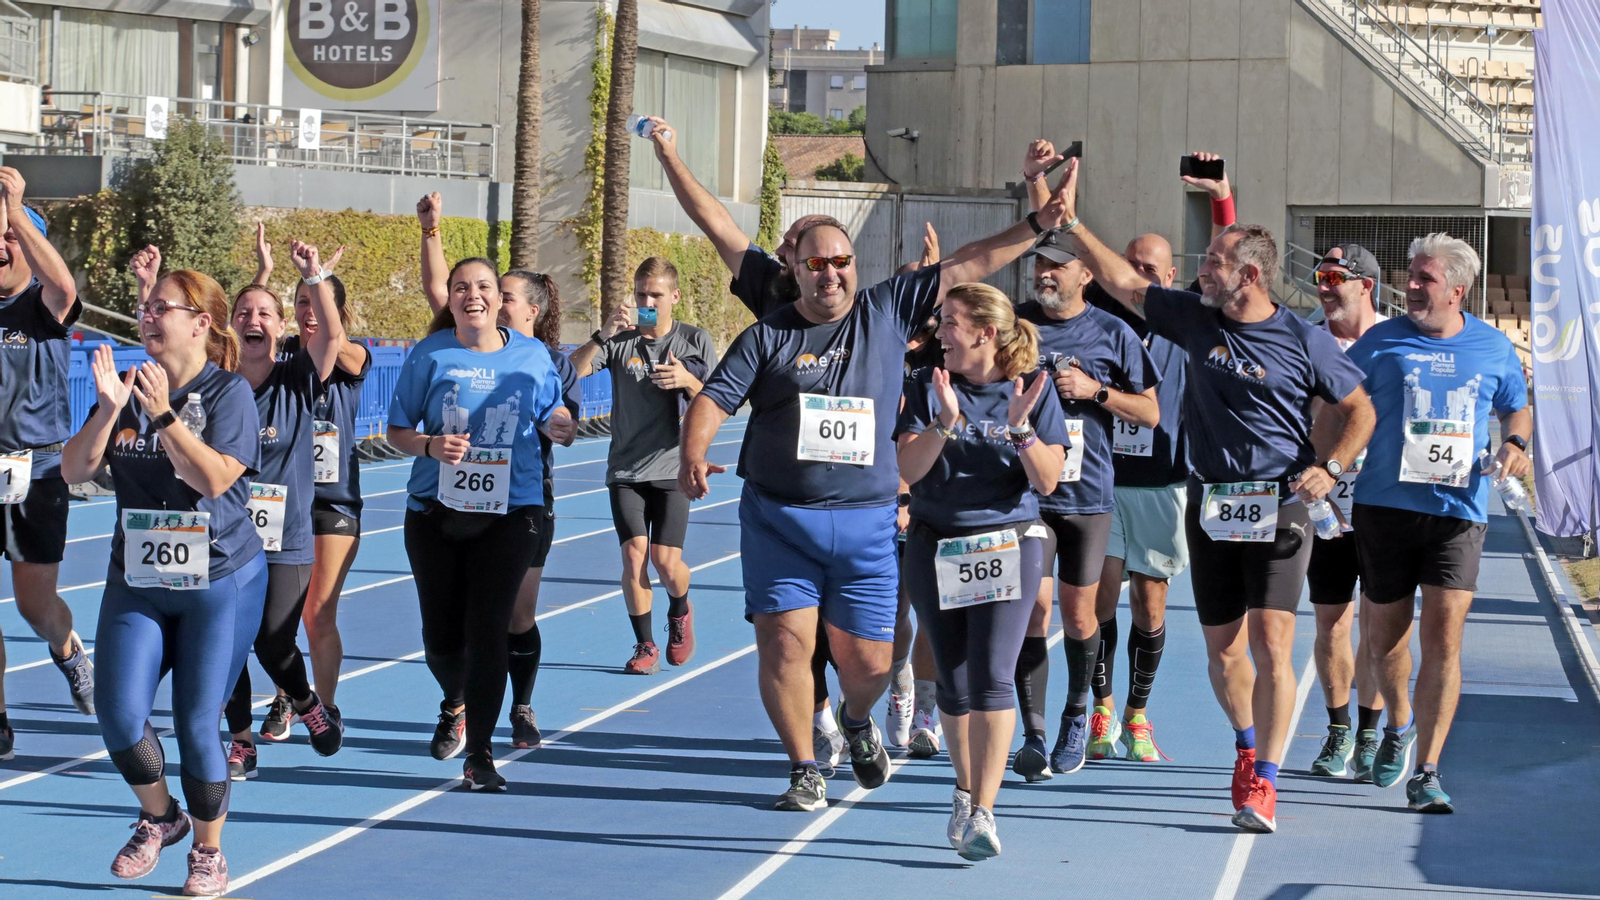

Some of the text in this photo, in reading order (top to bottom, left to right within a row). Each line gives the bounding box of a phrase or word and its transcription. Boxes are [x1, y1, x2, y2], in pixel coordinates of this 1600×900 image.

[299, 0, 411, 40] B&B
[313, 45, 393, 62] HOTELS
[1431, 353, 1454, 363] XLI
[473, 367, 495, 379] XLI
[819, 419, 857, 441] 601
[113, 450, 138, 458] Deporte
[1428, 444, 1453, 464] 54
[454, 470, 495, 492] 266
[1219, 503, 1261, 523] 848
[141, 541, 189, 565] 260
[959, 558, 1003, 583] 568
